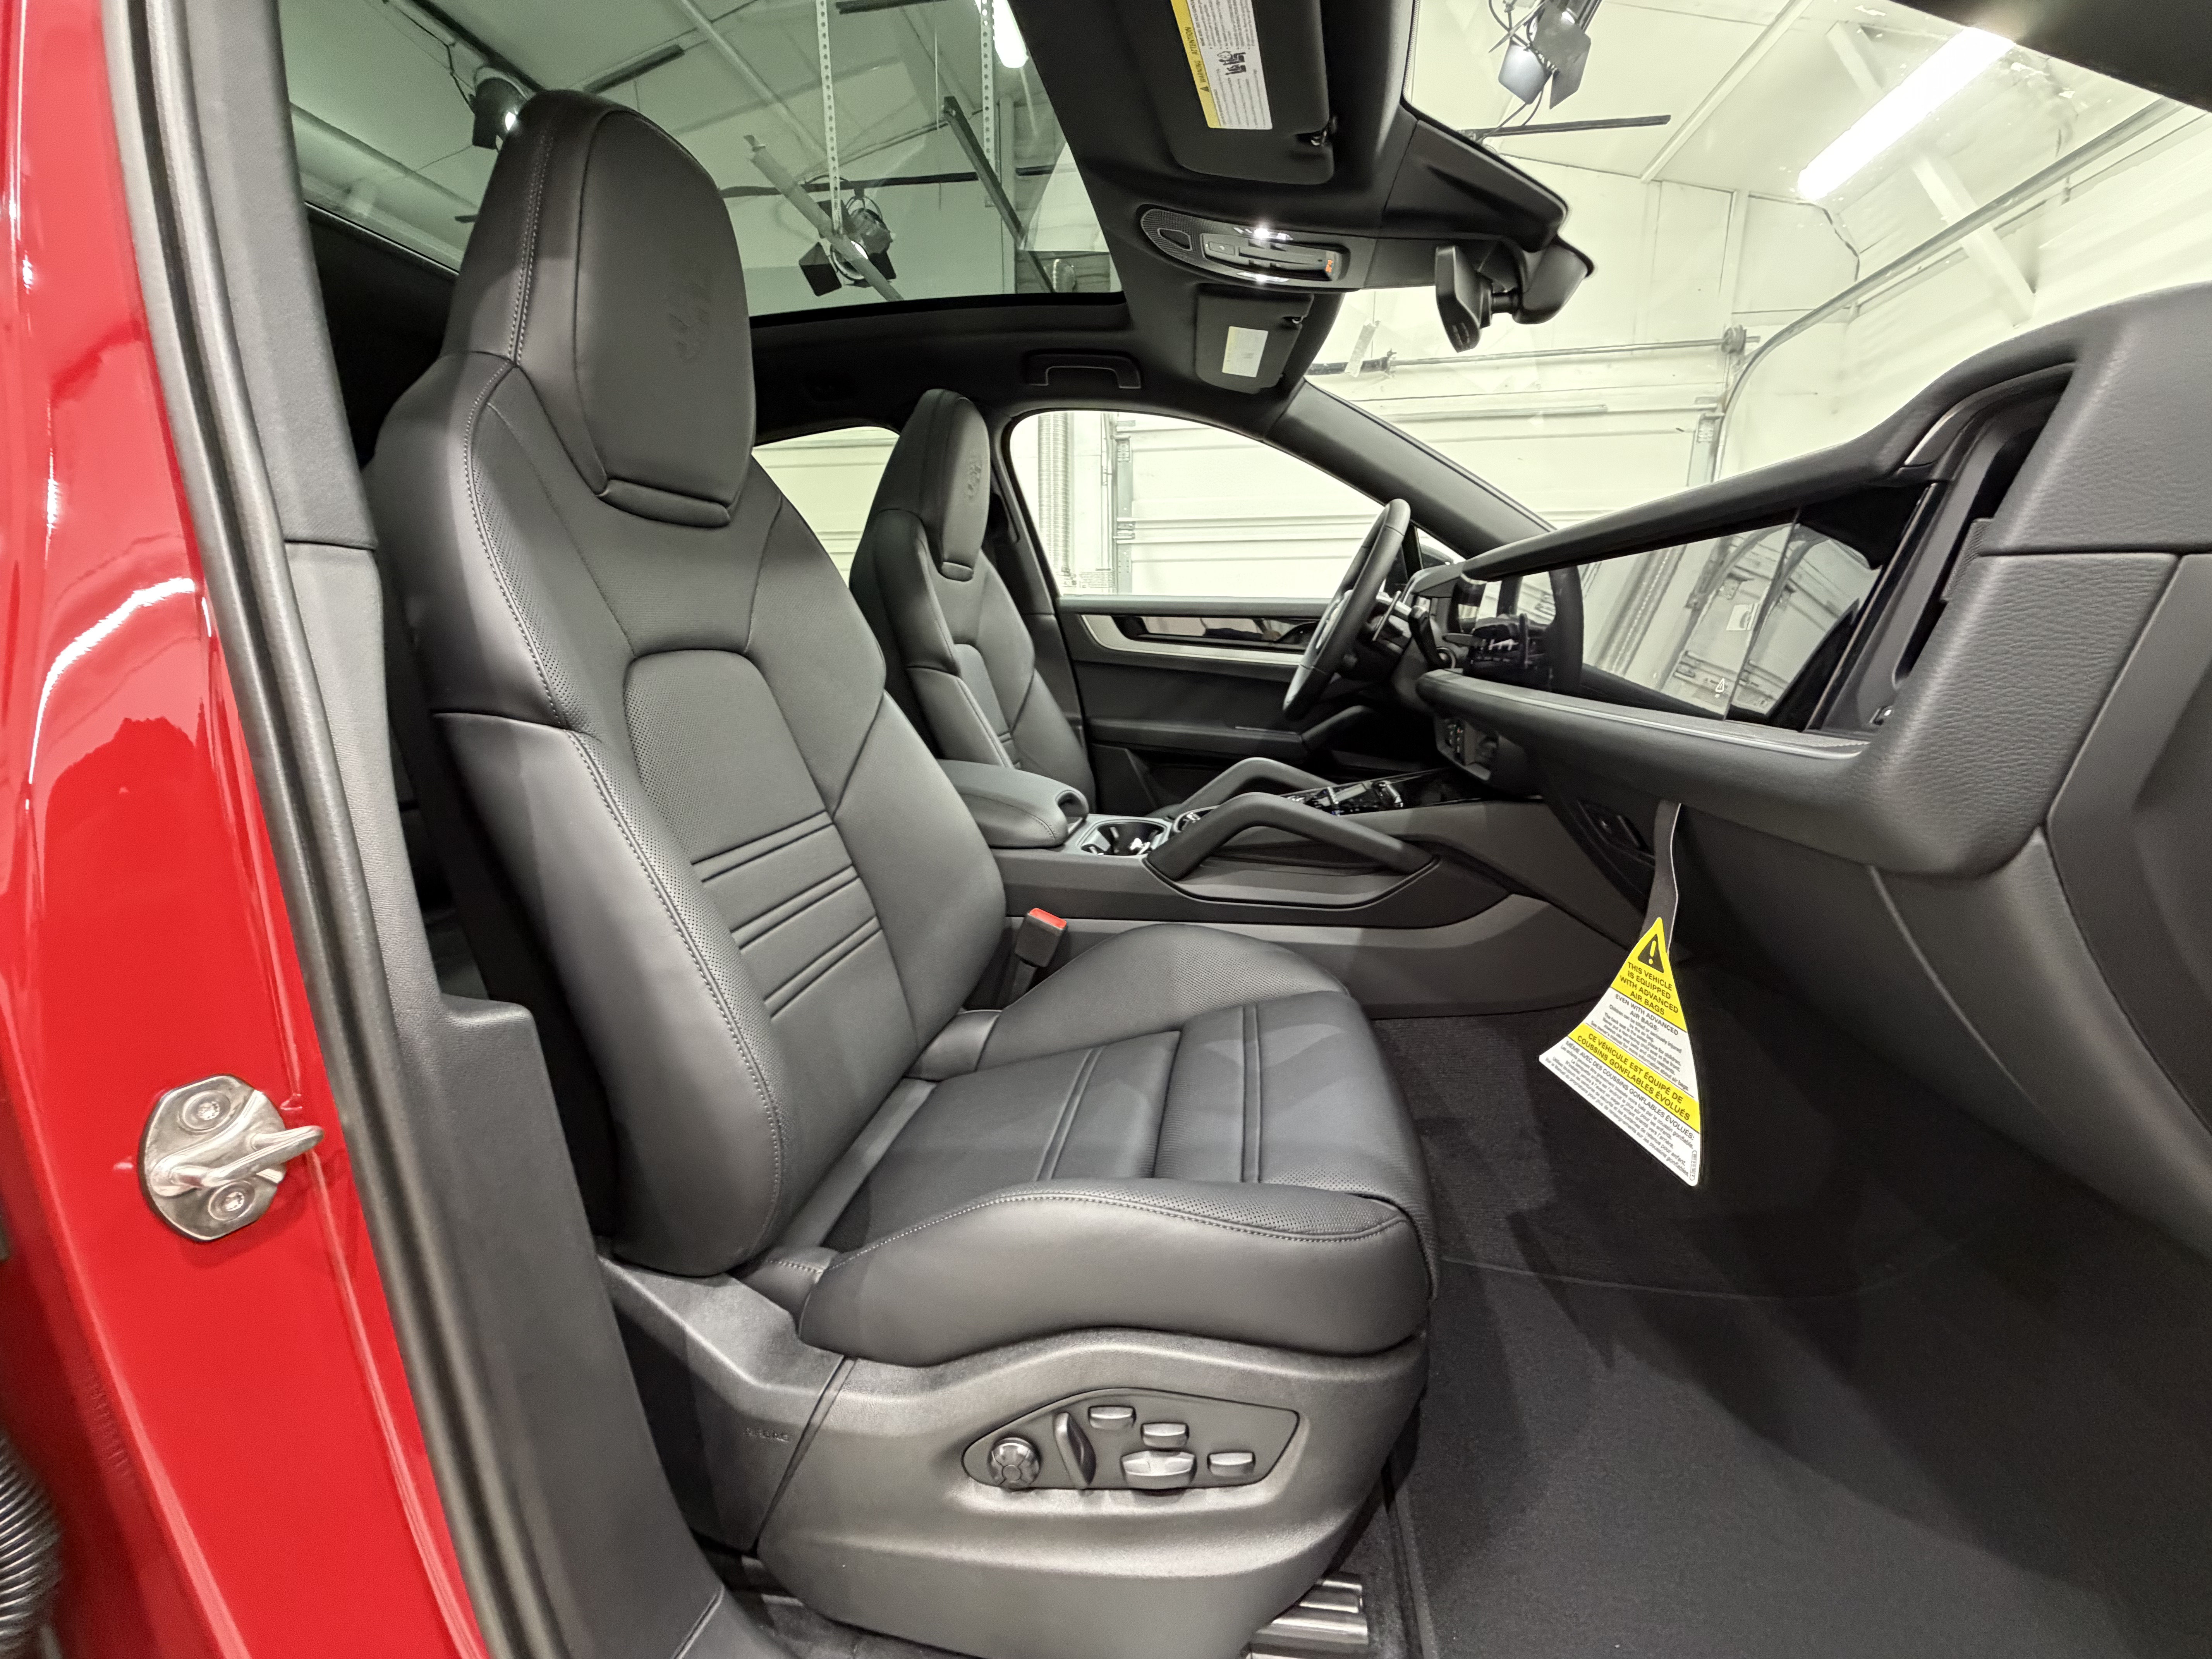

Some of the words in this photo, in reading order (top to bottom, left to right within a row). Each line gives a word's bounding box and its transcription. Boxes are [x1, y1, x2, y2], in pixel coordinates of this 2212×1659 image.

[1185, 27, 1197, 55] ATTENTION
[1628, 962, 1642, 974] THIS
[1644, 970, 1672, 991] VEHICLE
[1628, 970, 1634, 979] IS
[1636, 976, 1671, 999] EQUIPPED
[1620, 975, 1637, 990] WITH
[1638, 988, 1679, 1013] ADVANCED
[1630, 991, 1642, 1002] AIR
[1644, 998, 1664, 1015] BAGS
[1615, 994, 1629, 1006] EVEN
[1631, 1002, 1645, 1015] WITH
[1646, 1013, 1679, 1035] ADVANCED
[1630, 1011, 1640, 1020] AIR
[1641, 1017, 1659, 1032] BAGS:
[1578, 1035, 1608, 1061] COUSSINS
[1609, 1058, 1654, 1094] GONFLABLES
[1655, 1091, 1690, 1120] ÉVOLUÉS
[1588, 1033, 1597, 1042] CE
[1598, 1039, 1628, 1065] VÉHICULE
[1629, 1061, 1644, 1075] EST
[1644, 1072, 1671, 1095] ÉQUIPÉ
[1672, 1092, 1683, 1104] DE
[1580, 1052, 1593, 1063] AVEC
[1592, 1061, 1603, 1071] DES
[1603, 1069, 1629, 1090] COUSSINS
[1629, 1089, 1665, 1118] GONFLABLES
[1665, 1115, 1695, 1140] ÉVOLUÉS:
